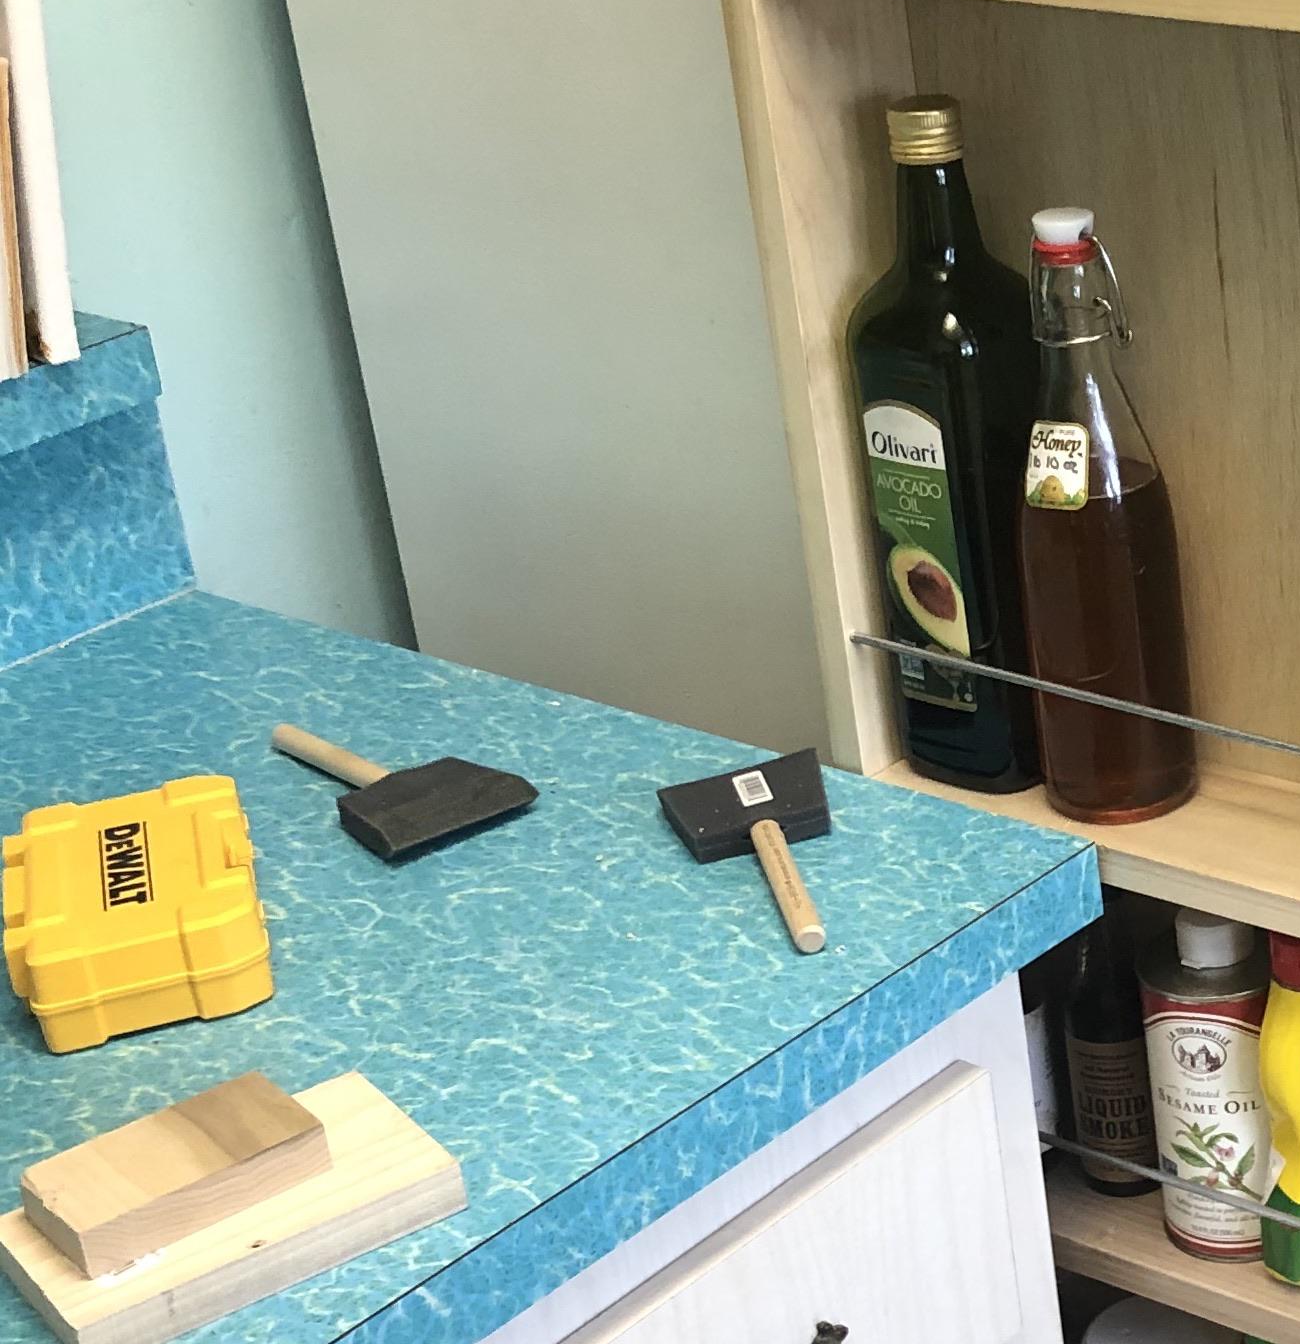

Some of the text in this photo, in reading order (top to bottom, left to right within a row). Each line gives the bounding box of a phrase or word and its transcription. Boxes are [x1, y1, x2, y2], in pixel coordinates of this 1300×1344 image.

[871, 430, 938, 465] Olivari
[1032, 429, 1082, 458] Honey
[876, 472, 942, 500] AVOCADO
[899, 496, 923, 515] OIL
[1077, 1090, 1147, 1118] LIQUID
[1158, 1087, 1262, 1115] SESAME OIL
